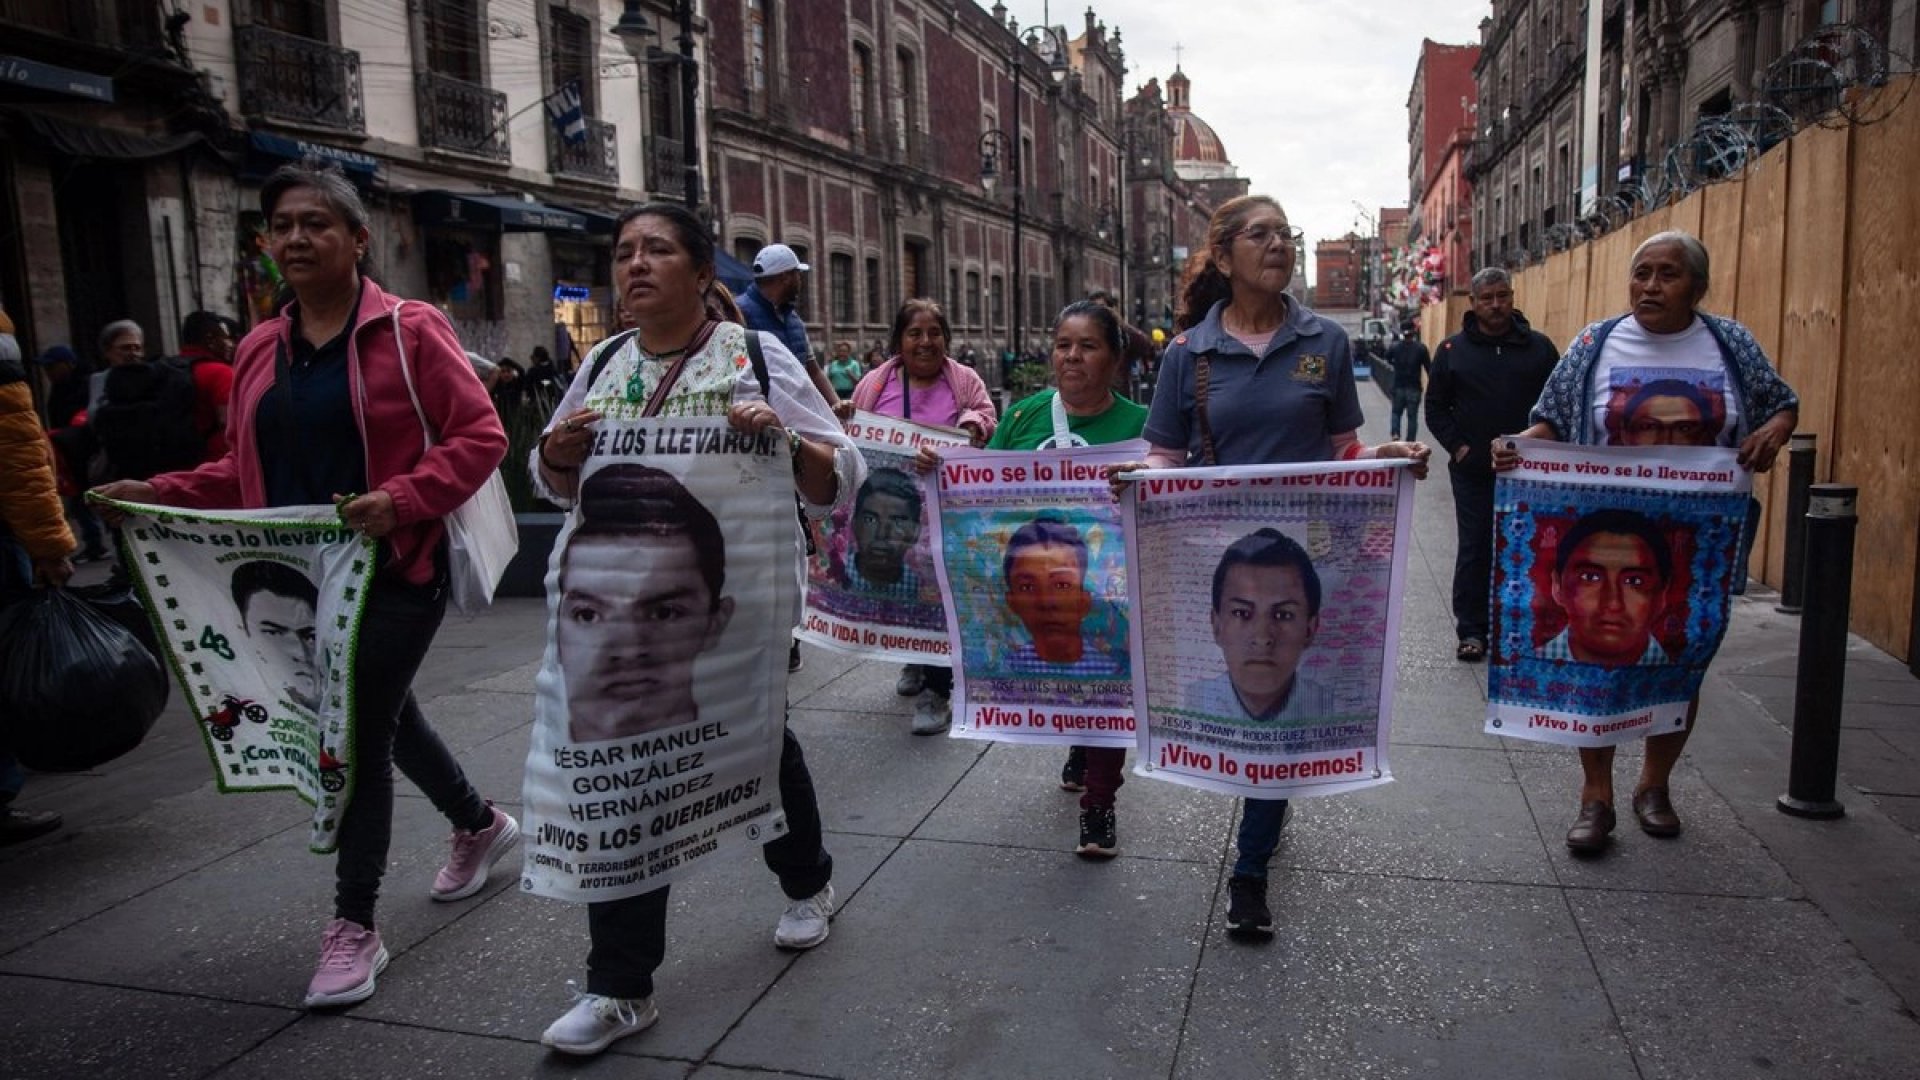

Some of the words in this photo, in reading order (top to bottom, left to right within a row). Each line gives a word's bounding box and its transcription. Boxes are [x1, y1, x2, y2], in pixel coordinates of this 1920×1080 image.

[611, 428, 647, 456] LOS
[866, 426, 884, 441] se
[888, 427, 904, 444] lo
[941, 464, 994, 490] ¡Vivo
[1002, 465, 1027, 482] se
[1034, 461, 1053, 481] lo
[1575, 461, 1609, 476] vivo
[1615, 467, 1633, 478] se
[1637, 464, 1653, 478] lo
[1658, 466, 1734, 483] llevaron!
[209, 534, 234, 548] se
[238, 529, 260, 548] lo
[200, 625, 235, 661] 43
[806, 616, 828, 634] ¡Con
[832, 622, 859, 644] VIDA
[864, 629, 877, 645] lo
[976, 706, 1022, 731] ¡Vivo
[1029, 709, 1045, 727] lo
[1052, 712, 1136, 732] queremo
[1528, 714, 1567, 731] ¡Vivo
[1572, 719, 1588, 733] lo
[1592, 711, 1653, 736] queremos!
[554, 745, 625, 768] CÉSAR
[632, 721, 728, 760] MANUEL
[573, 751, 705, 795] GONZÁLEZ
[1160, 742, 1212, 770] ¡Vivo
[1219, 753, 1238, 775] lo
[1245, 751, 1364, 784] queremos!
[568, 772, 714, 822] HERNÁNDEZ
[537, 823, 589, 852] ¡VIVOS
[599, 824, 642, 850] LOS
[650, 777, 762, 836] QUEREMOS!
[578, 855, 645, 875] TERRORISMO
[647, 848, 660, 862] DE
[579, 871, 646, 889] AYOTZINAPA
